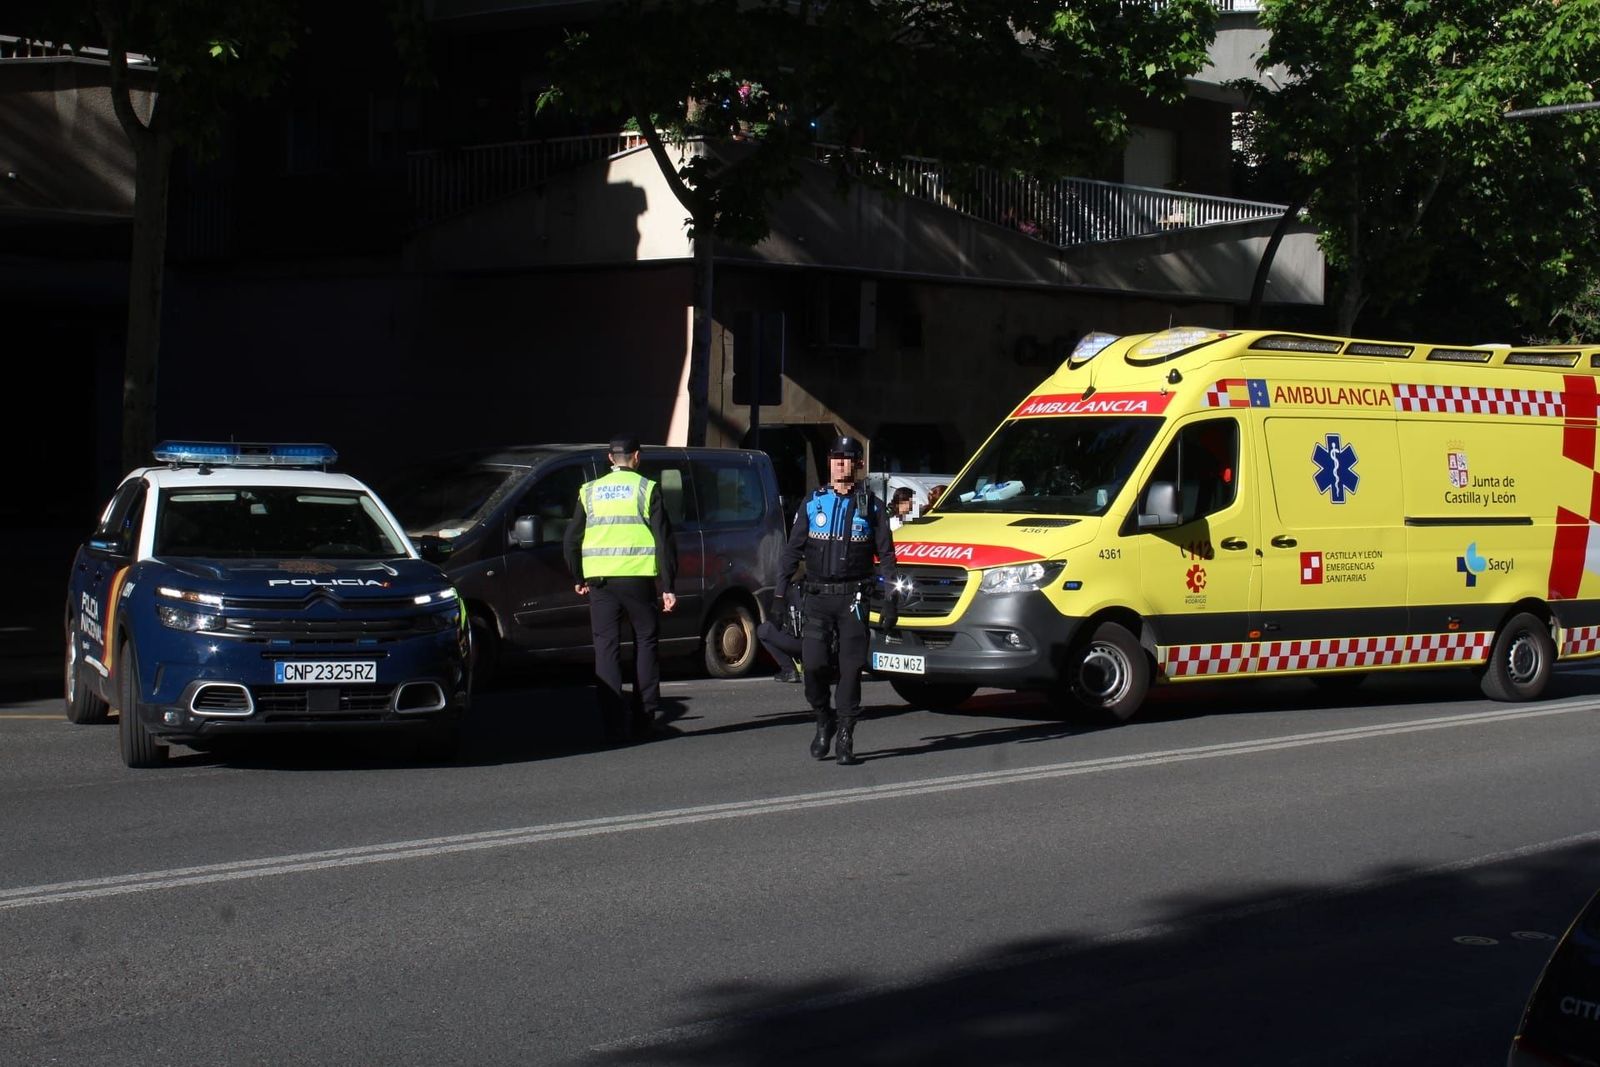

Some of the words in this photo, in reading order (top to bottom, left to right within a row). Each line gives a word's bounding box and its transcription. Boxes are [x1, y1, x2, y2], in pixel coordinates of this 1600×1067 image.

[1274, 386, 1392, 407] AMBULANCIA
[1020, 399, 1148, 416] AMBULANCIA
[1472, 475, 1500, 488] Junta
[1502, 475, 1515, 488] de
[1444, 491, 1481, 504] Castilla
[1483, 494, 1490, 507] y
[1491, 491, 1517, 504] León
[1098, 548, 1121, 560] 4361
[1325, 551, 1357, 560] CASTILLA
[1357, 551, 1364, 560] Y
[1326, 562, 1375, 571] EMERGENCIAS
[1488, 557, 1515, 574] Sacyl
[1326, 573, 1367, 583] SANITARIAS
[878, 655, 900, 670] 6743
[903, 657, 923, 671] MGZ
[284, 664, 375, 680] CNP2325RZ
